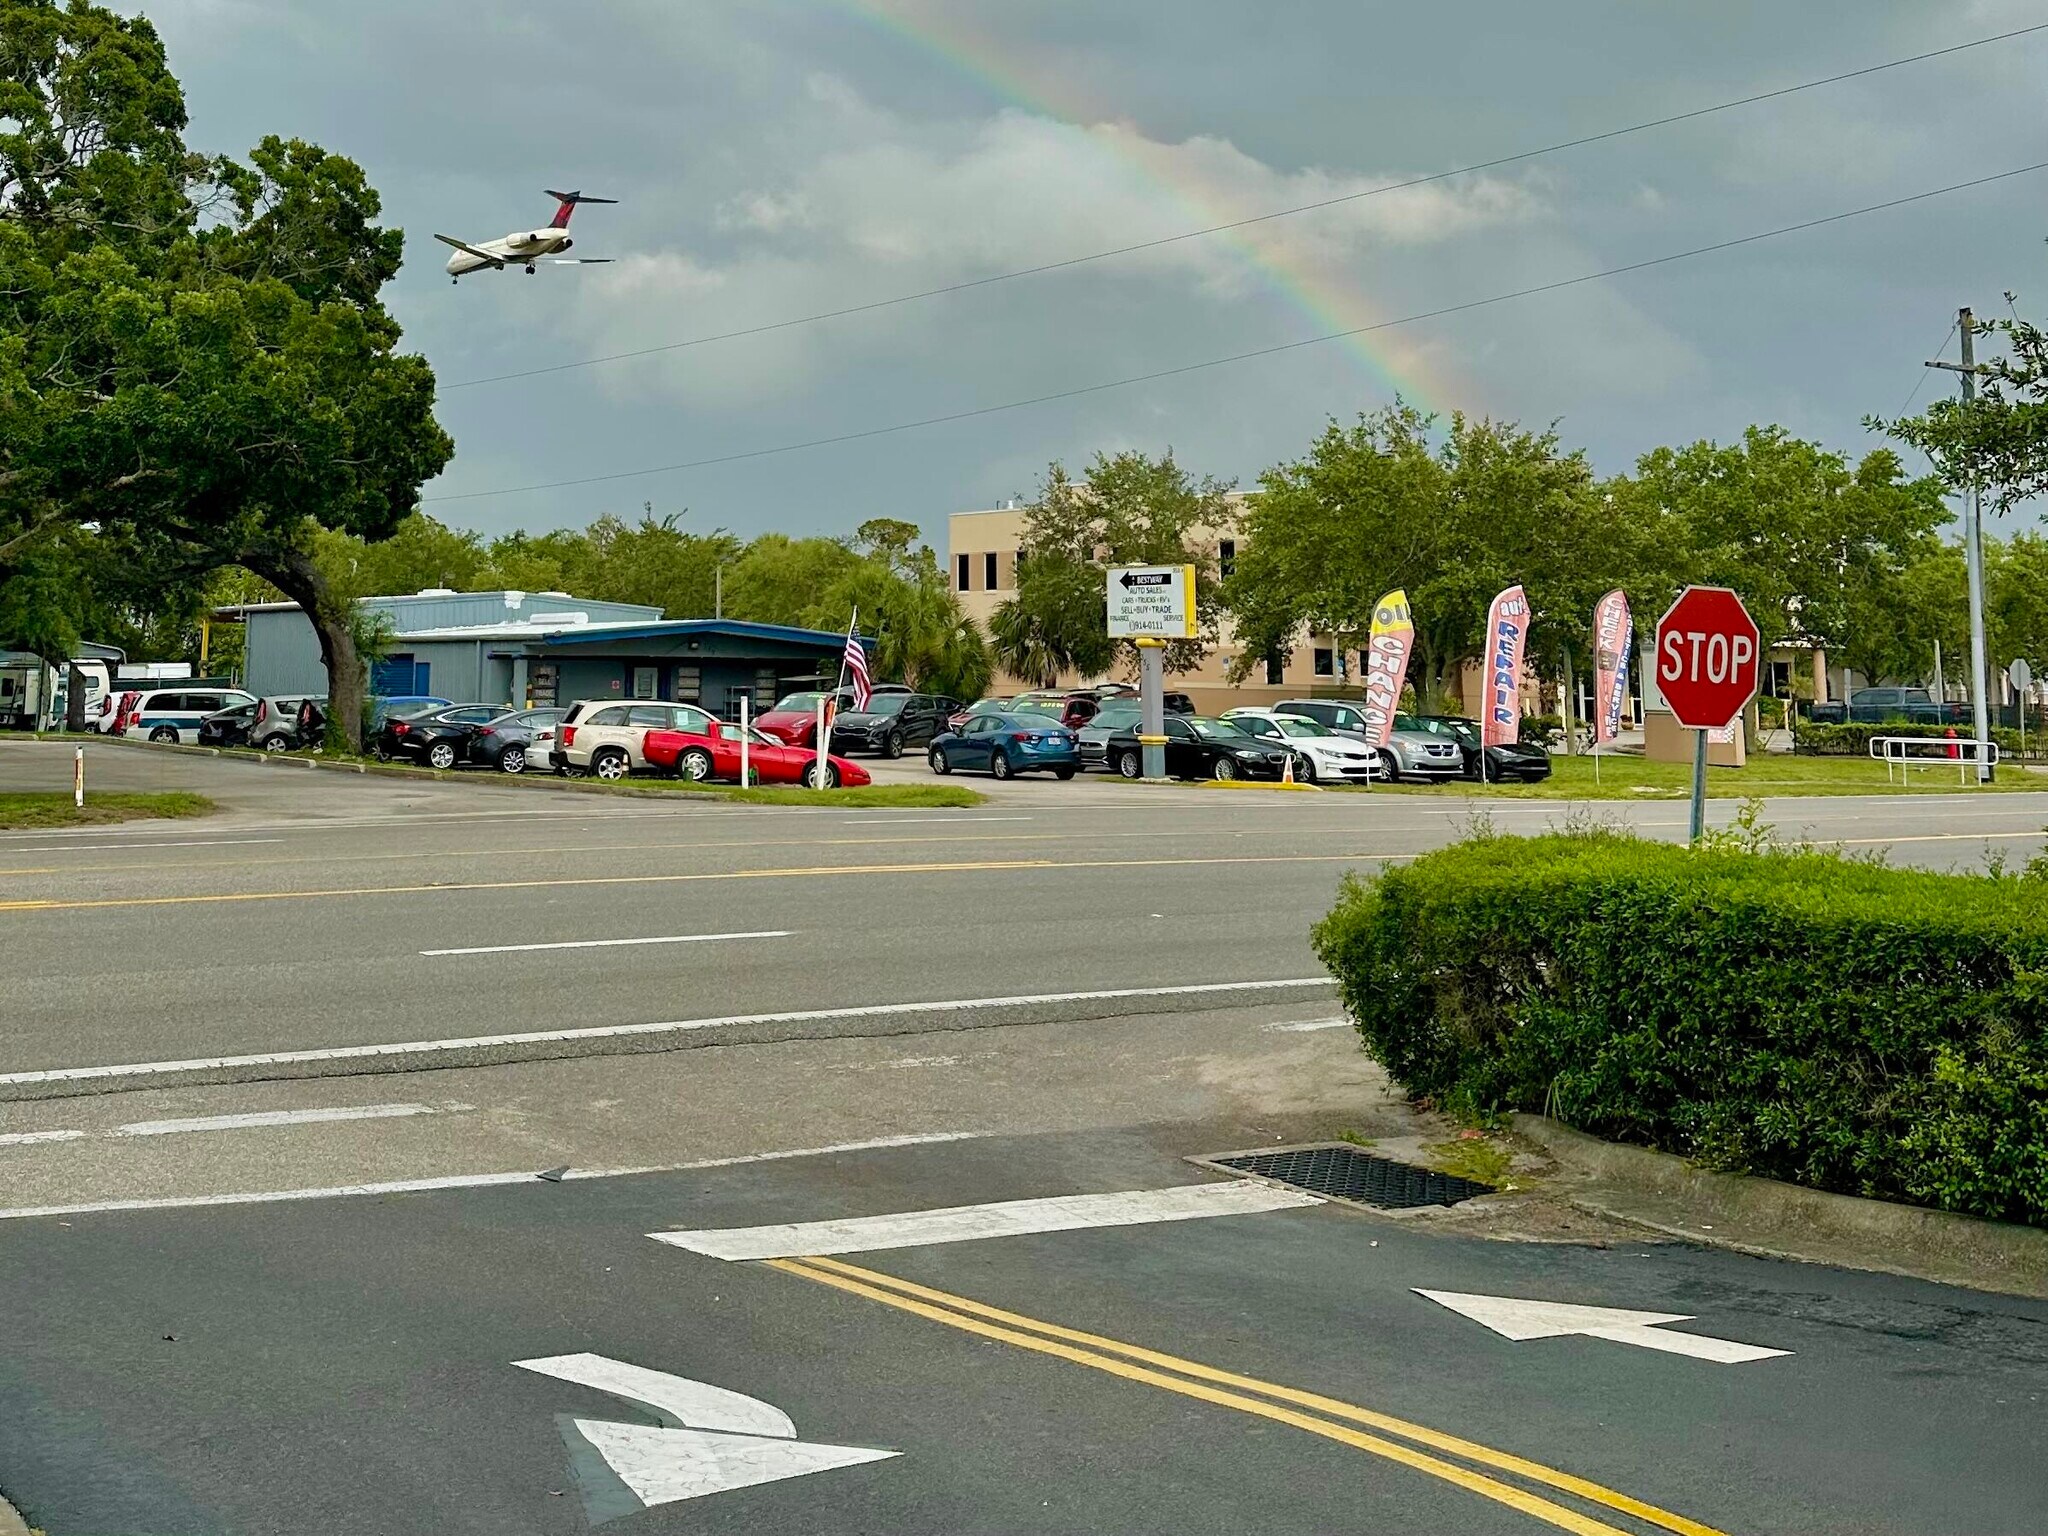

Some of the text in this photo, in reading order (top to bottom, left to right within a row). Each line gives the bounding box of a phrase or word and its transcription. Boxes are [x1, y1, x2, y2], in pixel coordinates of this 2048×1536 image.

[1137, 575, 1163, 584] BESTWAY
[1146, 586, 1162, 594] SALES
[1151, 605, 1172, 613] TRADE
[1499, 596, 1525, 618] aut
[1599, 597, 1623, 650] CHECK
[1493, 620, 1520, 726] REPAIR
[1661, 630, 1753, 684] STOP
[1362, 635, 1405, 745] CHANGE
[1610, 683, 1623, 732] SERVICE
